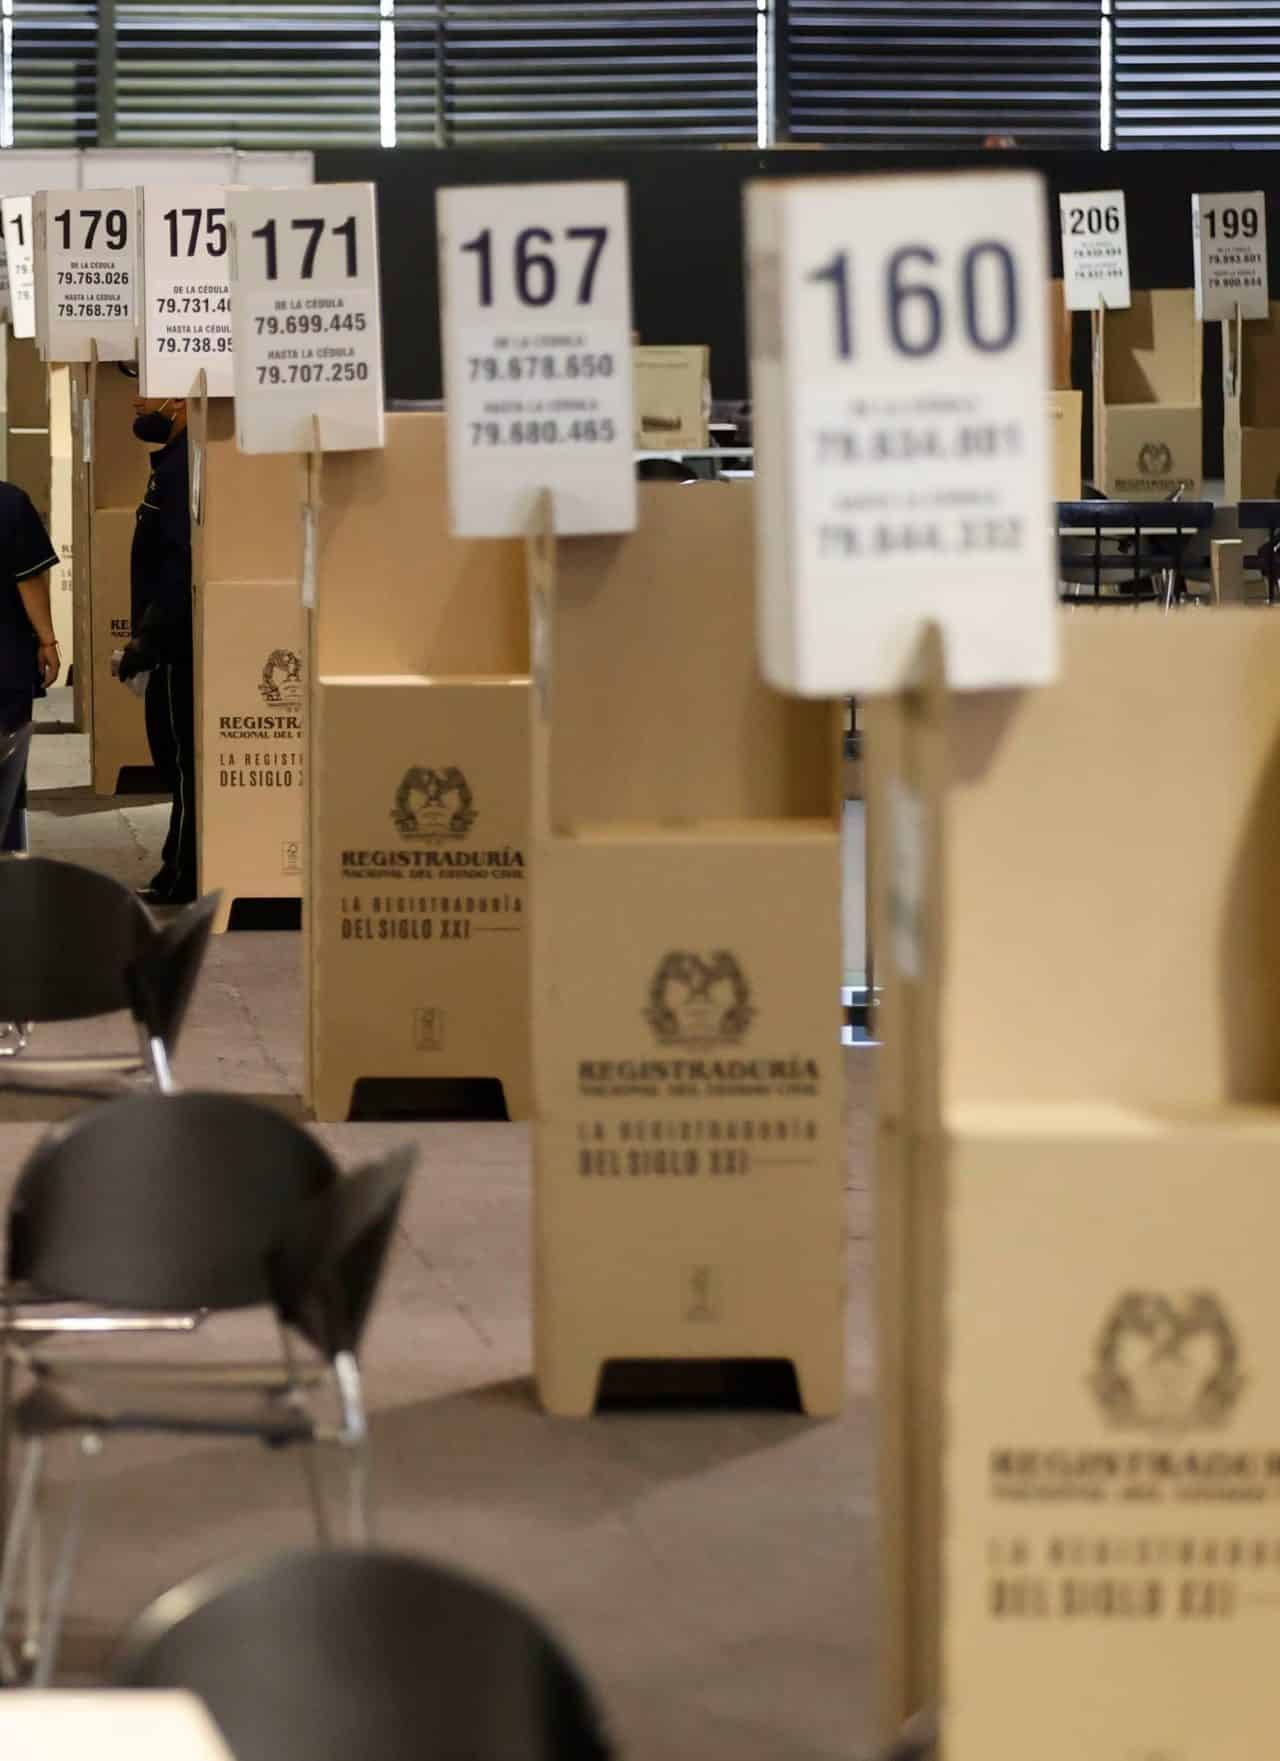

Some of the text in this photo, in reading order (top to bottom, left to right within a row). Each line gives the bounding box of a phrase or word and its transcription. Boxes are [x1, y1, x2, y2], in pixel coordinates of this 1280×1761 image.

[1070, 206, 1120, 234] 206
[1203, 208, 1258, 239] 199
[54, 209, 128, 250] 179
[163, 208, 227, 257] 175
[251, 216, 358, 280] 171
[460, 226, 609, 308] 167
[57, 272, 129, 285] 79.763.026
[173, 285, 229, 294] DE LA CÉDULA
[156, 298, 231, 313] 79.731.4
[290, 300, 302, 310] LA
[806, 239, 1020, 361] 160
[58, 304, 129, 317] 79.768.791
[166, 324, 231, 334] HASTA LA CÉDUL
[254, 313, 366, 335] 79.699.445
[157, 338, 232, 352] 79.738.95
[301, 349, 313, 359] LA
[256, 362, 368, 384] 79.707.250
[219, 716, 302, 729] REGISTR
[220, 753, 234, 766] LA
[220, 770, 246, 786] DEL
[249, 770, 292, 786] SIGLO
[341, 846, 525, 867] REGISTRADURÍA
[342, 896, 361, 912] LA
[342, 918, 470, 939] DEL SIGLO XXI
